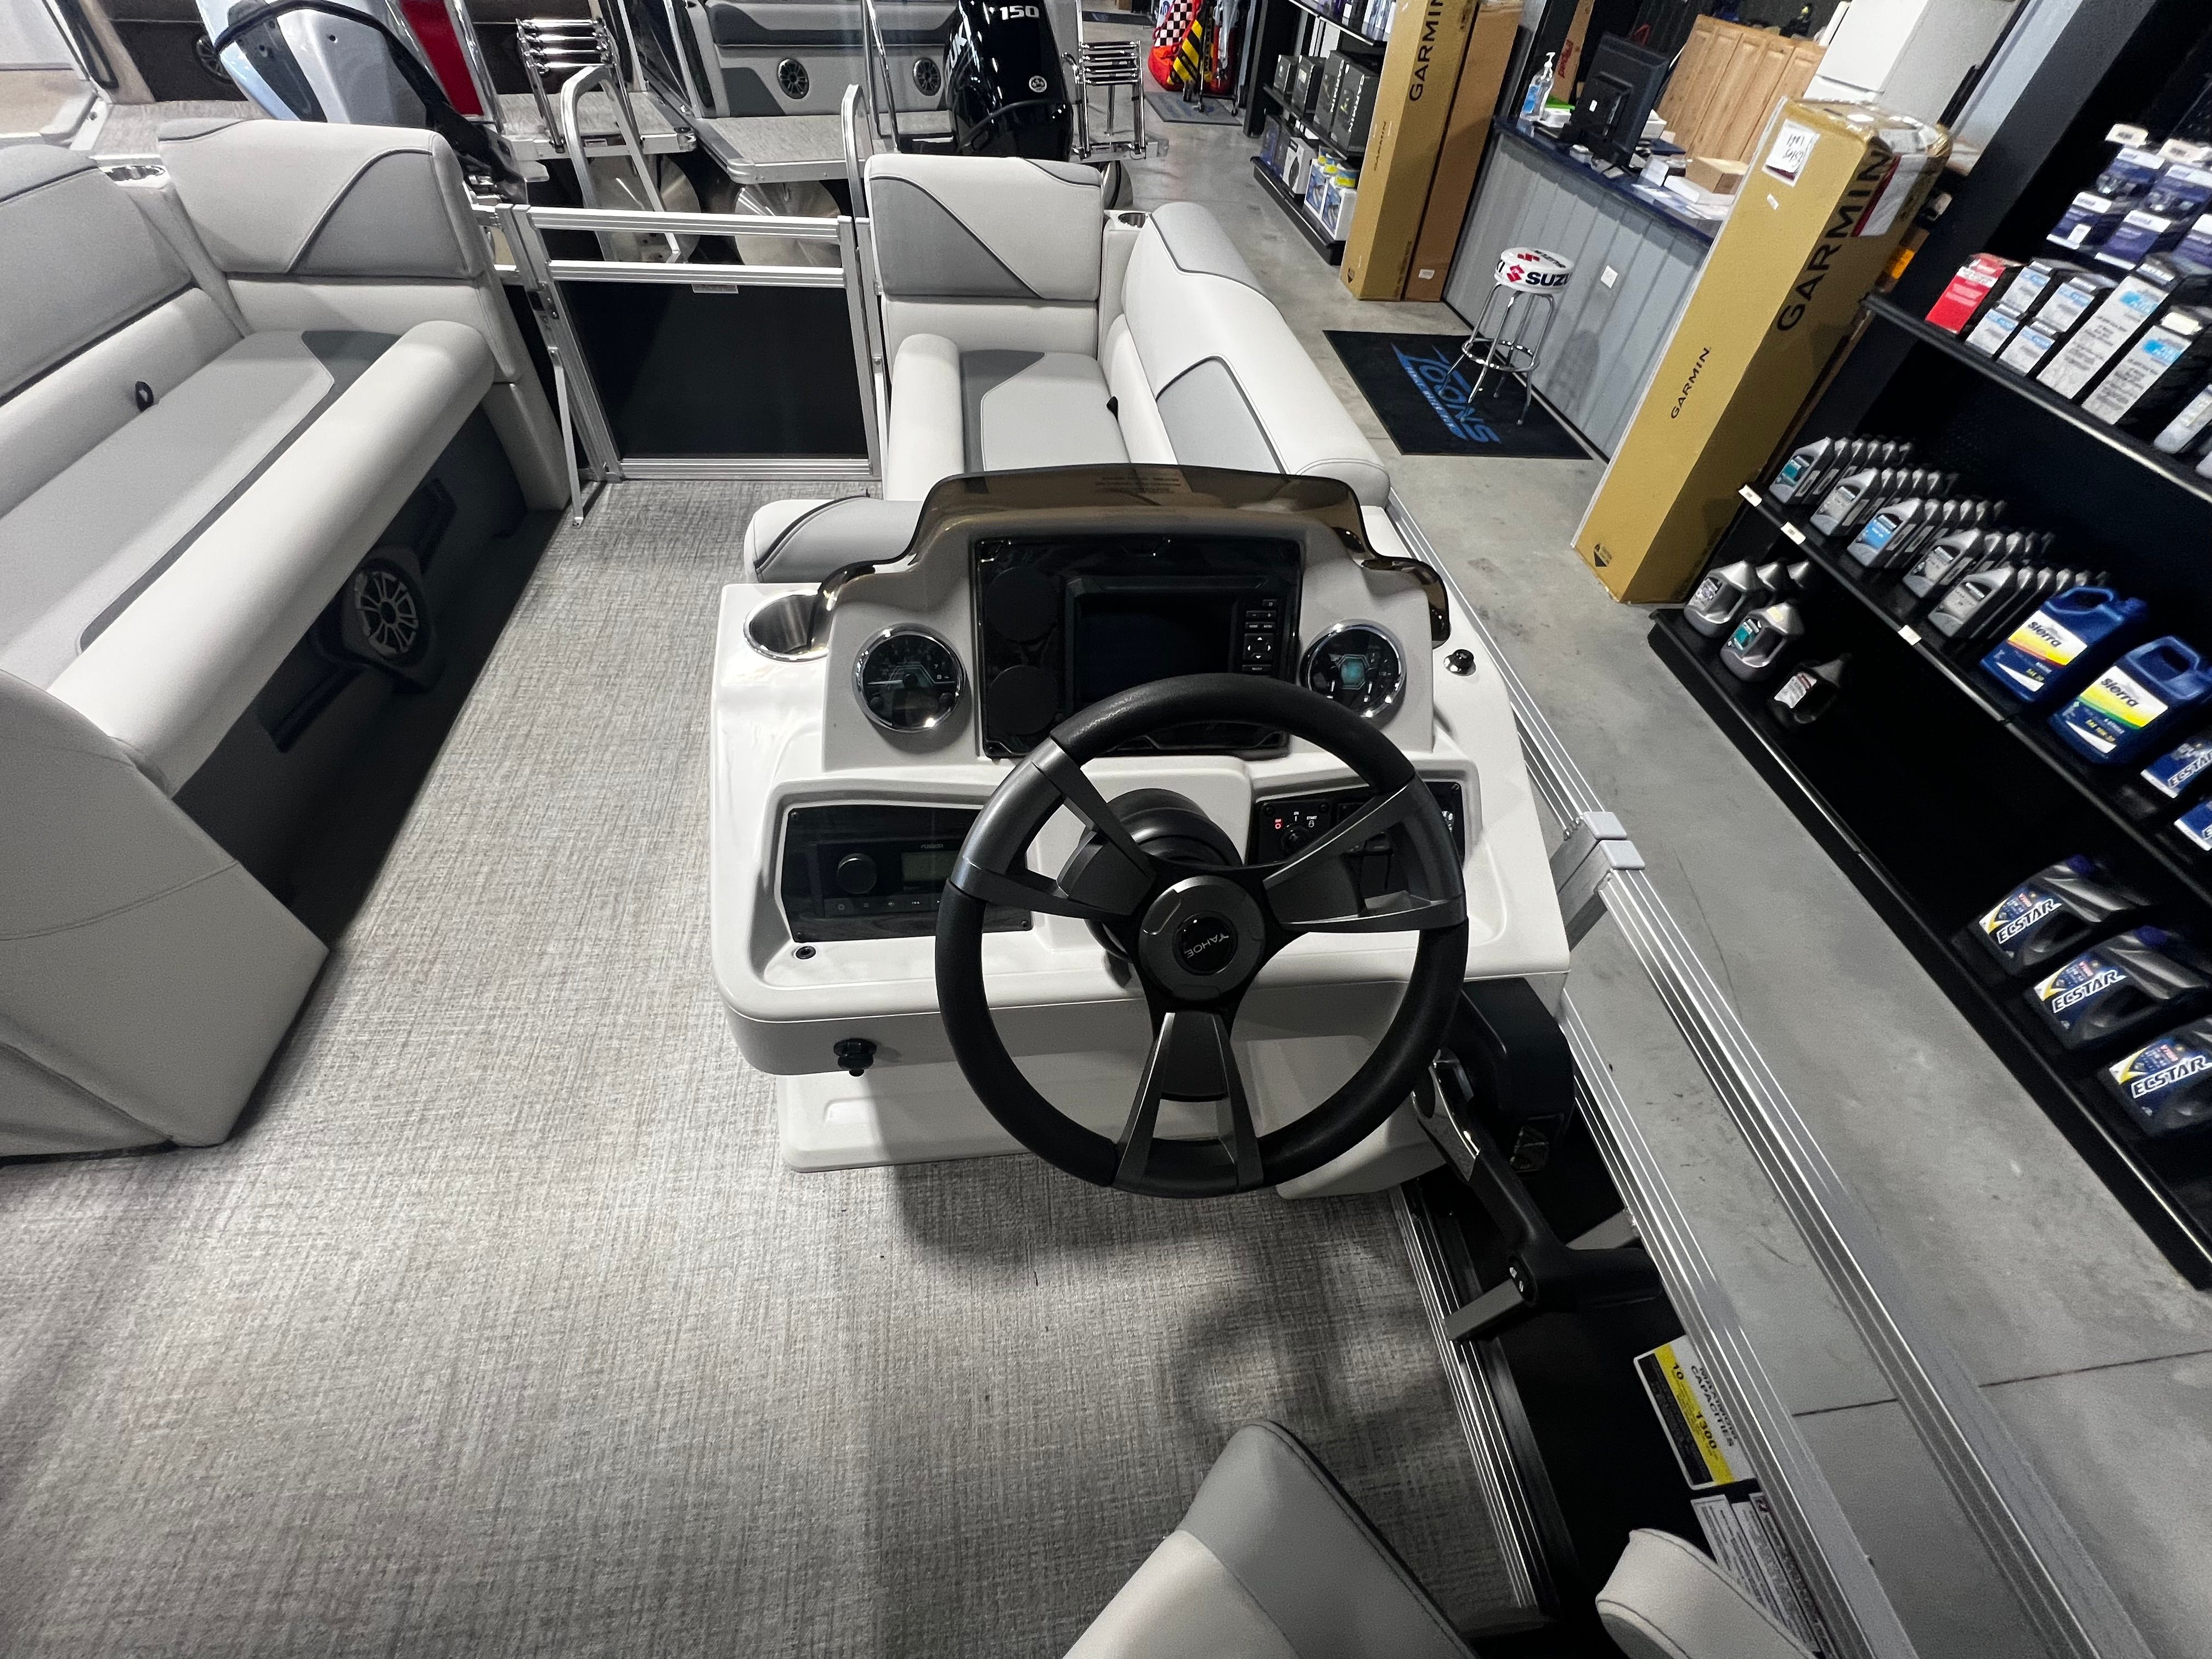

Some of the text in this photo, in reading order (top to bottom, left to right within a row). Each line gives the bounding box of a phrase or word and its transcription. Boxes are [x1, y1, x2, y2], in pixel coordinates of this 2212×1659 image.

[999, 5, 1040, 20] 150
[1777, 149, 1893, 331] GARMIN
[1671, 347, 1711, 419] GARMIN
[1996, 898, 2062, 944] ECSTAR
[1184, 933, 1229, 958] TAHOE
[2052, 969, 2127, 1013] ECSTAR
[2131, 1054, 2212, 1099] ECSTAR
[1673, 1362, 1718, 1449] 10 1300
[1691, 1365, 1734, 1447] CAPACITIES
